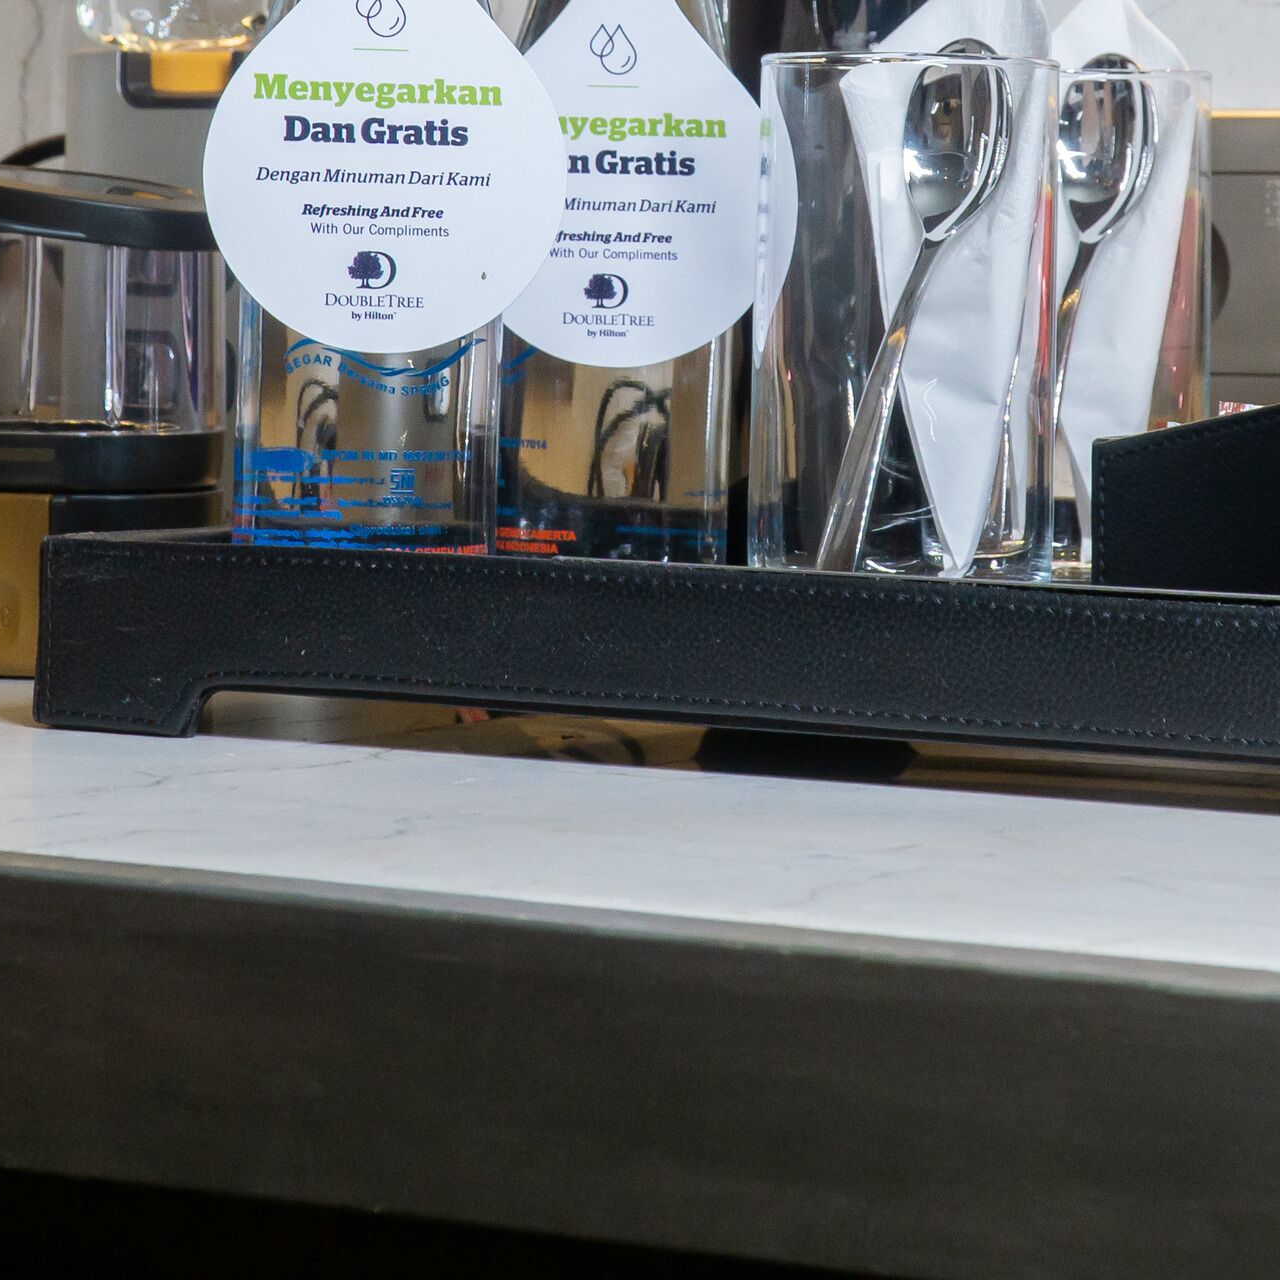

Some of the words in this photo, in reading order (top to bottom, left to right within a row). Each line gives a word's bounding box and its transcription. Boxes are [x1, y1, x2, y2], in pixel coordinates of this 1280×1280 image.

[253, 73, 502, 109] Menyegarkan
[284, 115, 356, 143] Dan
[361, 117, 469, 146] Gratis
[595, 150, 695, 176] Gratis
[256, 167, 320, 185] Dengan
[323, 169, 405, 184] Minuman
[408, 171, 444, 186] Dari
[446, 172, 491, 187] Kami
[301, 204, 378, 219] Refreshing
[380, 206, 410, 218] And
[411, 207, 444, 219] Free
[564, 197, 637, 212] Minuman
[639, 199, 673, 213] Dari
[675, 200, 716, 214] Kami
[311, 222, 338, 234] With
[342, 223, 364, 235] Our
[369, 224, 449, 238] Compliments
[555, 230, 612, 244] freshing
[613, 232, 641, 243] And
[642, 233, 673, 243] Free
[550, 247, 574, 258] With
[578, 248, 599, 259] Our
[603, 249, 678, 262] Compliments
[351, 311, 362, 321] by
[587, 329, 597, 338] by
[285, 354, 333, 374] SEGAR
